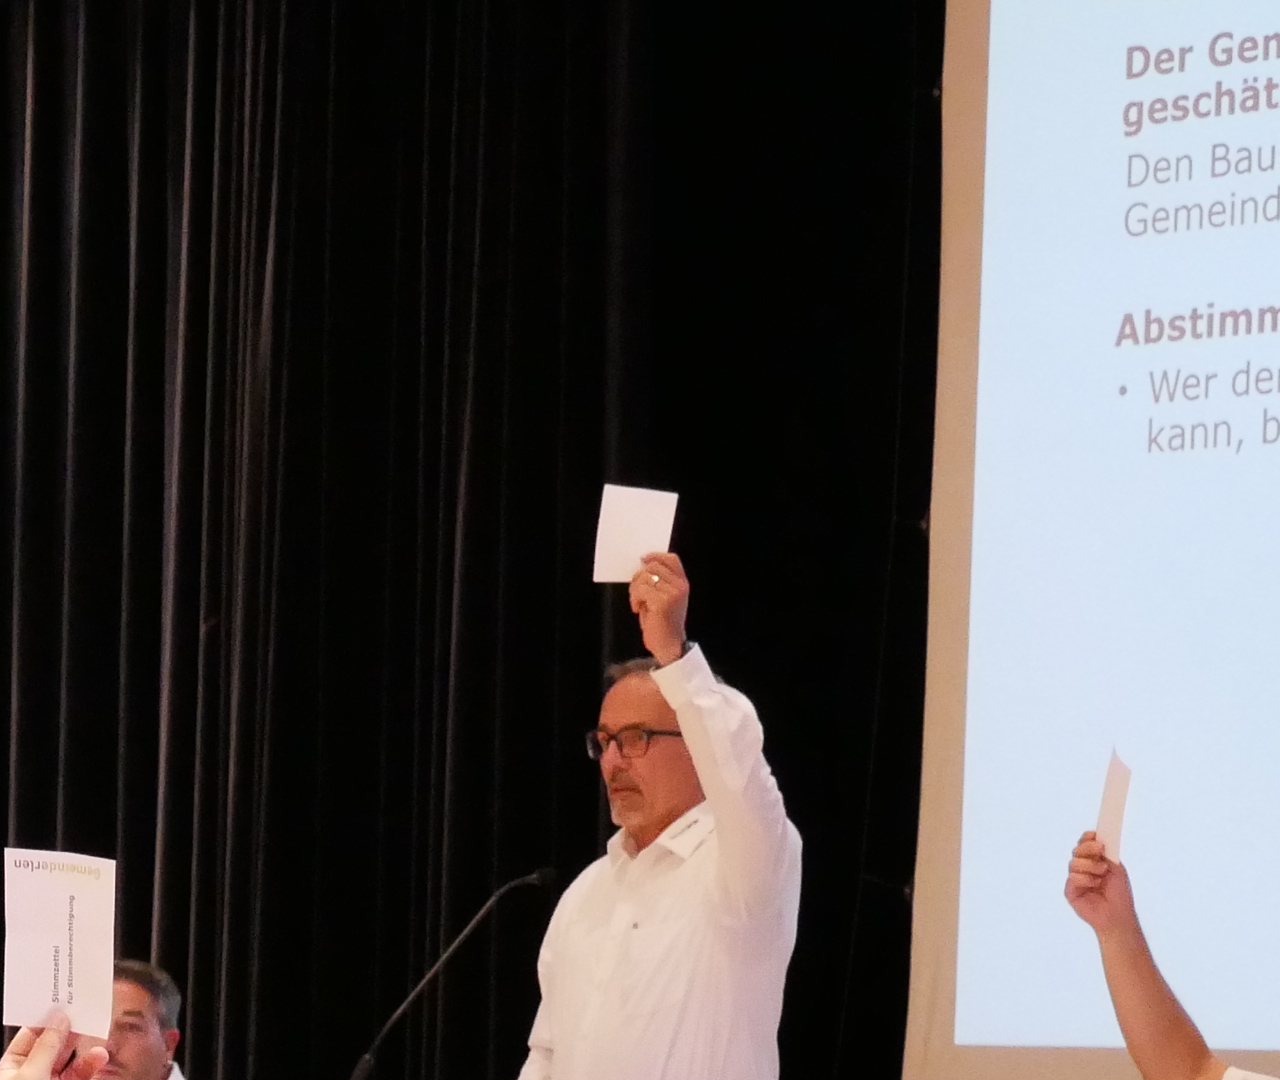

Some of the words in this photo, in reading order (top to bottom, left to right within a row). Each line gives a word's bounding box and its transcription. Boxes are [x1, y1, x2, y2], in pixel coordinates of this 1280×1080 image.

[1126, 45, 1194, 80] Der
[1123, 77, 1279, 137] geschät
[1127, 152, 1194, 188] Den
[1211, 143, 1276, 178] Bau
[1124, 185, 1280, 237] Gemeind
[1114, 302, 1280, 348] Abstimm
[1149, 369, 1218, 403] Wer
[1231, 360, 1280, 399] de
[1148, 418, 1244, 454] kann,
[67, 894, 76, 988] Stimmberechtigung
[52, 945, 60, 1004] Stimmzettel
